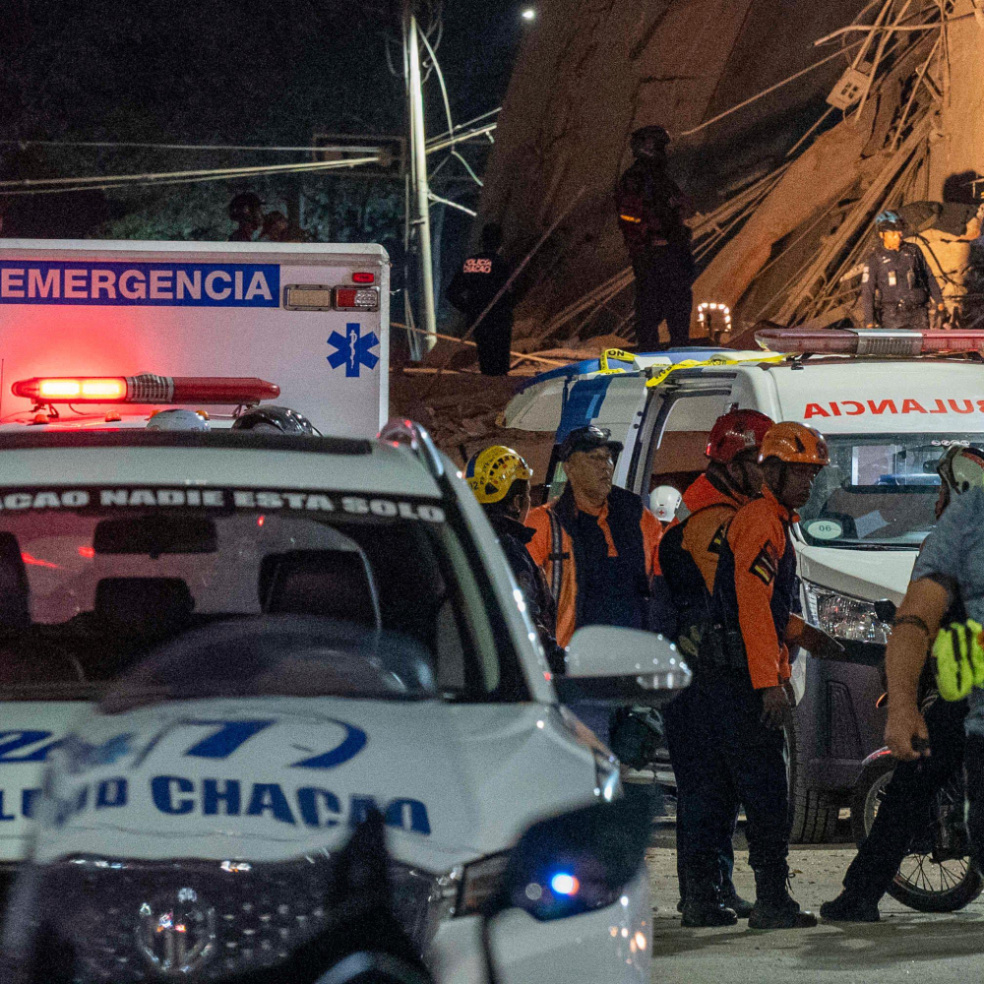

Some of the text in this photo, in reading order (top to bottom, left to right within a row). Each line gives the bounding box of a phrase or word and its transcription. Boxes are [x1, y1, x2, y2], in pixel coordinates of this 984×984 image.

[0, 268, 273, 301] EMERGENCIA
[0, 489, 446, 523] CAO NADIE ESTA SOLO
